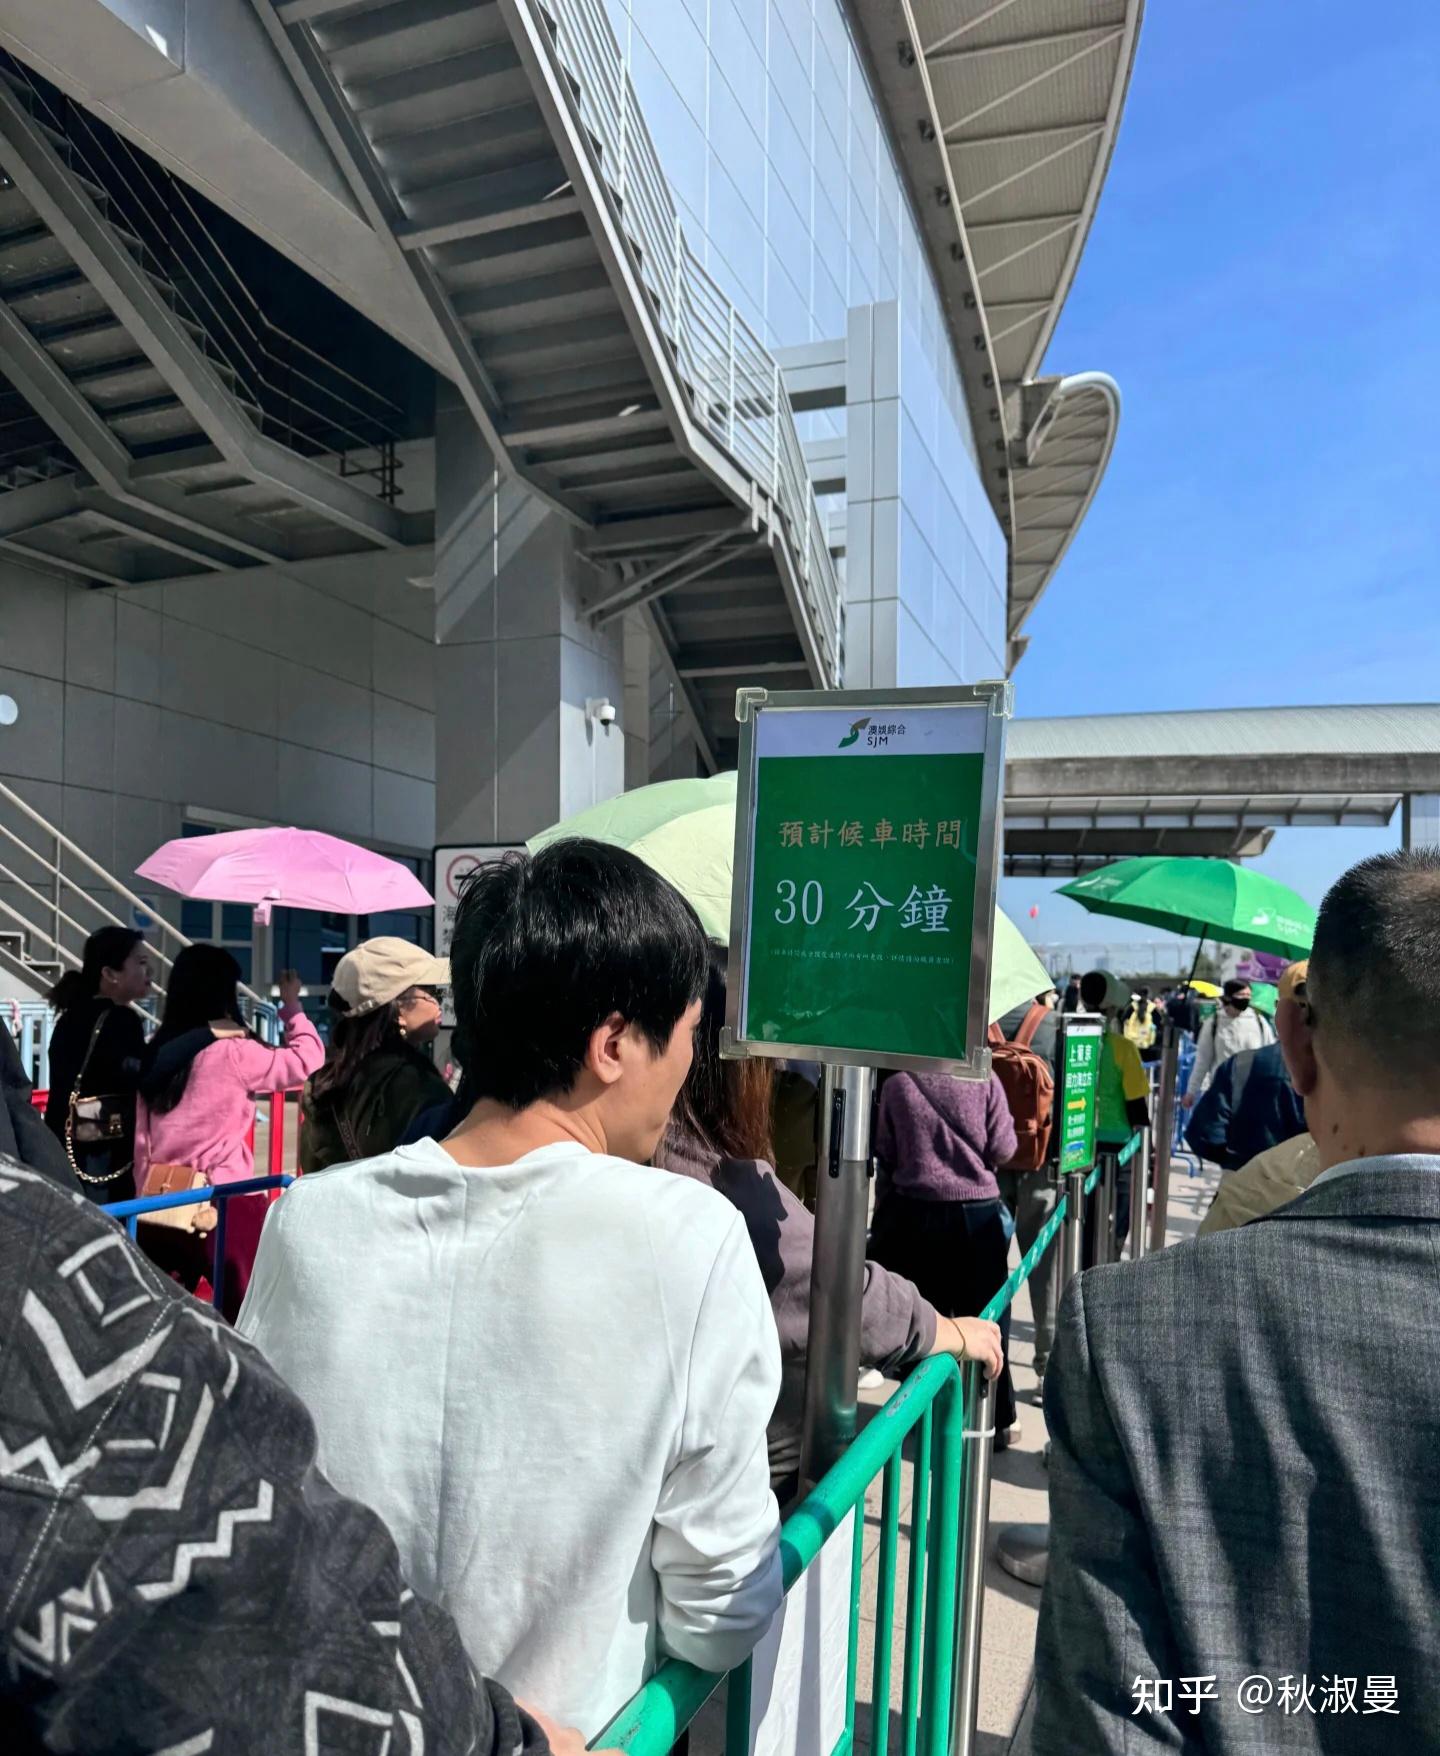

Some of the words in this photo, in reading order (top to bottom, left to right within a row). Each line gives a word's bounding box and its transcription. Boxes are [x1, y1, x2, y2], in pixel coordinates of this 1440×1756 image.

[868, 724, 906, 735] 澳娛綜合
[867, 736, 888, 748] SJM
[778, 818, 962, 850] 預計候車時間
[774, 879, 823, 925] 30
[844, 881, 953, 933] 分鐘
